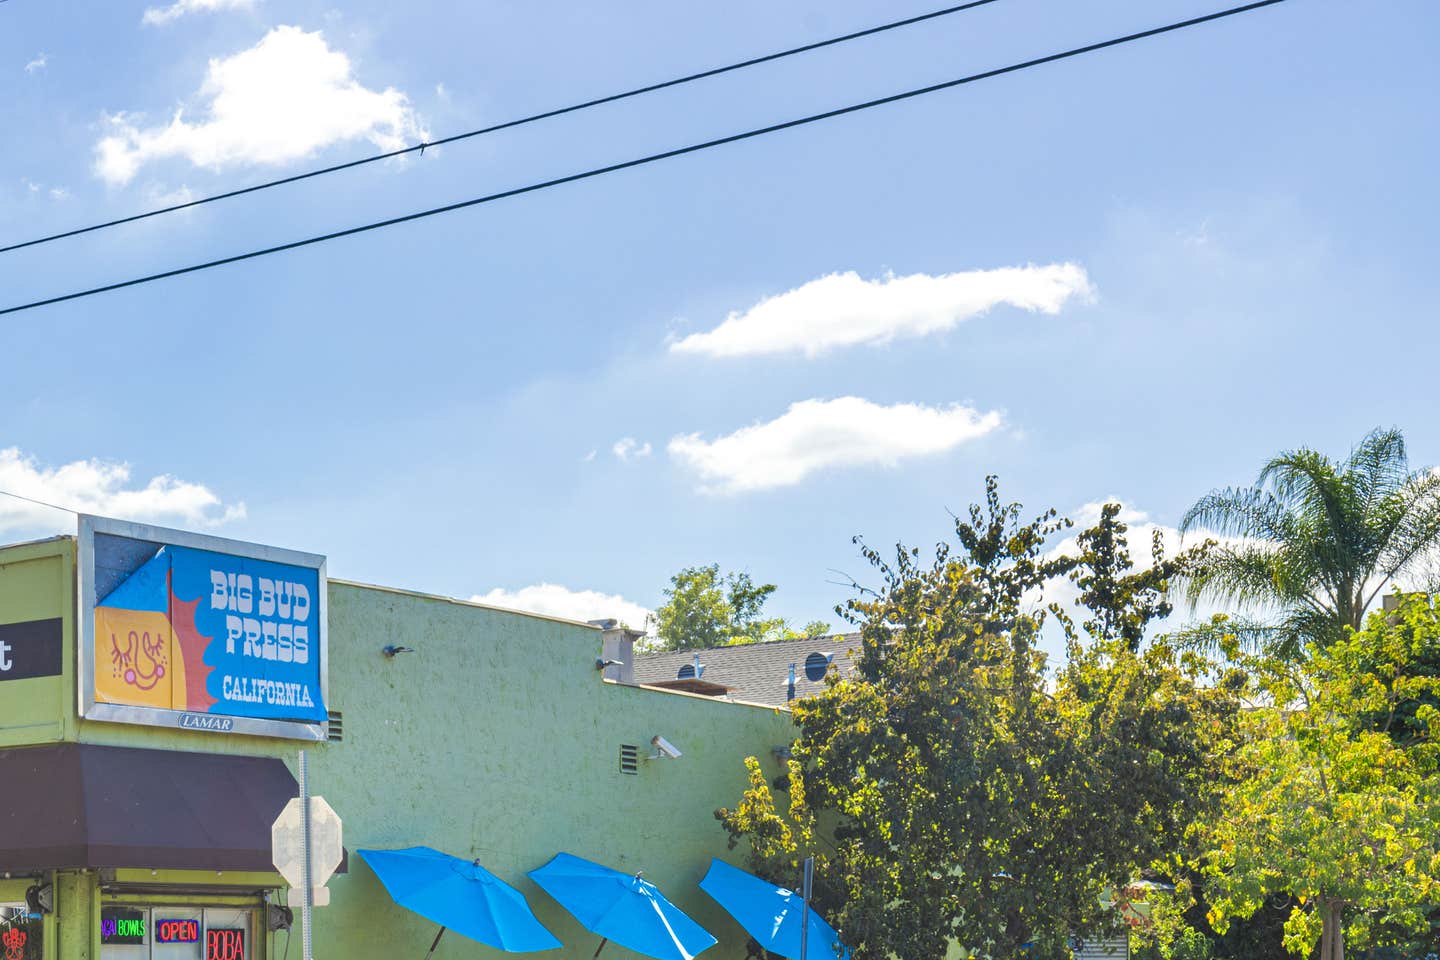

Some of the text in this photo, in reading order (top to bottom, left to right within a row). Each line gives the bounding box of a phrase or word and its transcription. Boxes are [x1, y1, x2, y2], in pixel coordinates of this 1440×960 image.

[210, 569, 310, 622] BIG BUD
[226, 615, 309, 665] PRESS
[222, 675, 315, 708] CALIFORNIA
[182, 715, 232, 731] LAMAR
[117, 919, 146, 937] BOWLS
[161, 921, 198, 941] OPEN
